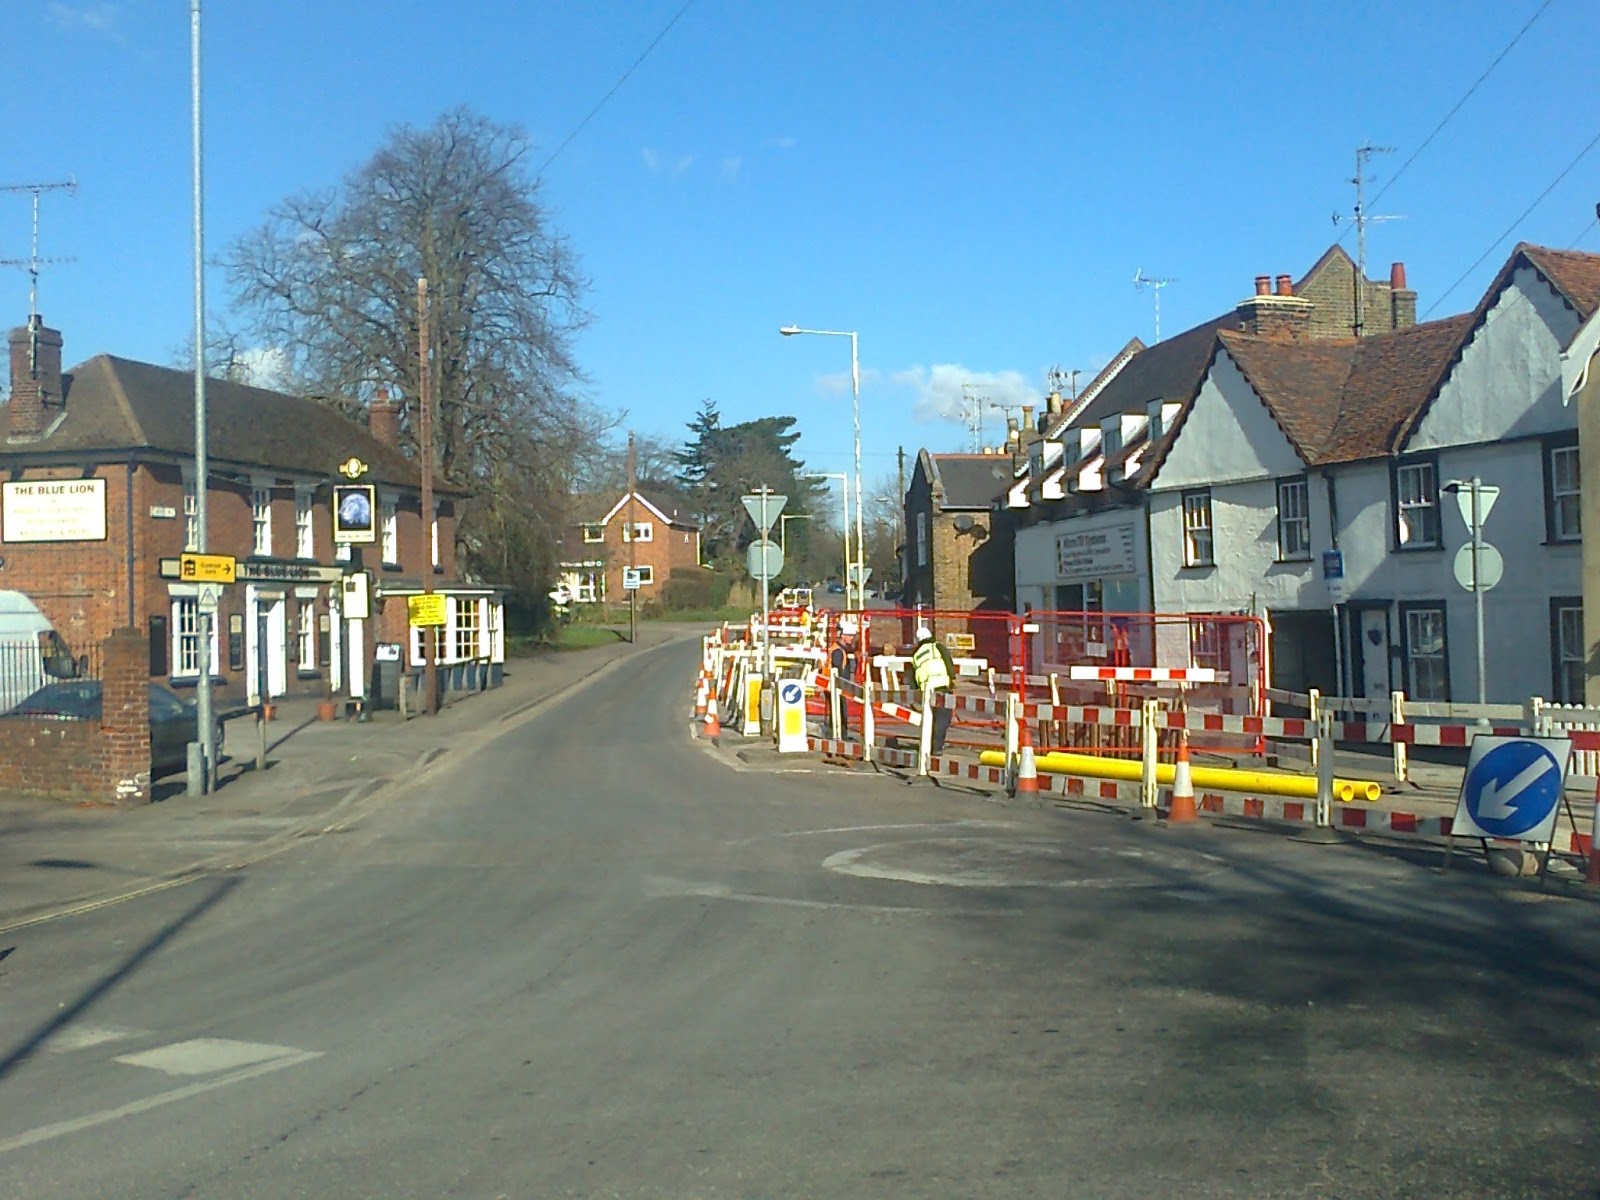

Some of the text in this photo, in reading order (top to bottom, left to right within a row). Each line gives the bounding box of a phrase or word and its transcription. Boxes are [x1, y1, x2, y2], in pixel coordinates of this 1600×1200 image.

[14, 484, 95, 495] THE BLUE LION
